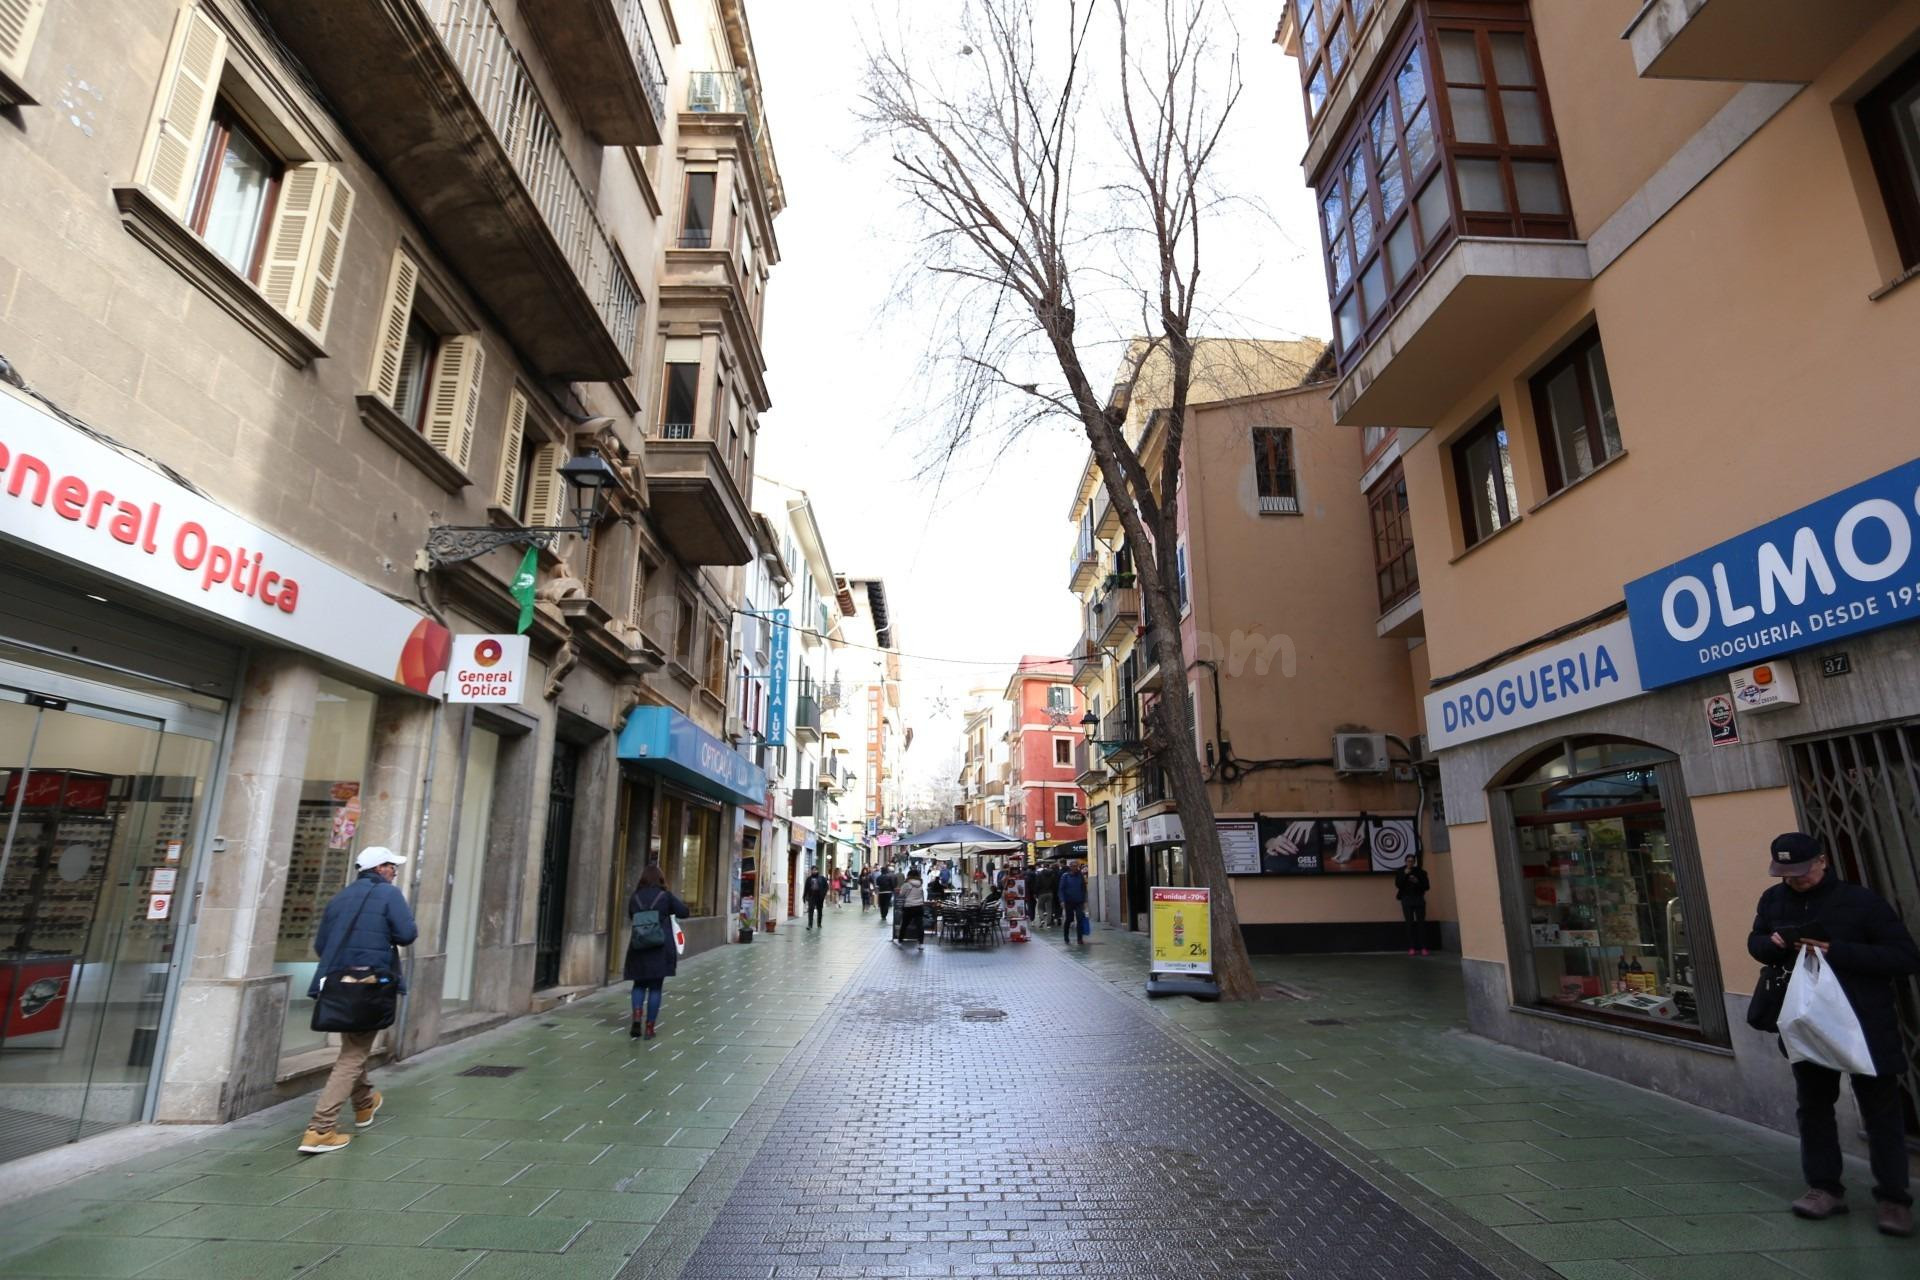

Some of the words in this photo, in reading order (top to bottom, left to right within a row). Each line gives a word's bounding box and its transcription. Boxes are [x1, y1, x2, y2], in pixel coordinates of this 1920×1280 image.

[0, 440, 161, 555] neral
[173, 521, 300, 614] Optica
[1661, 484, 1920, 642] OLMO
[1699, 620, 1803, 664] DROGUERIA
[1808, 596, 1880, 632] DESDE
[458, 670, 512, 682] General
[1824, 656, 1844, 673] 37
[461, 683, 507, 698] Optica
[1442, 644, 1619, 734] DROGUERIA
[771, 712, 781, 741] LUX
[1163, 892, 1187, 900] unidad
